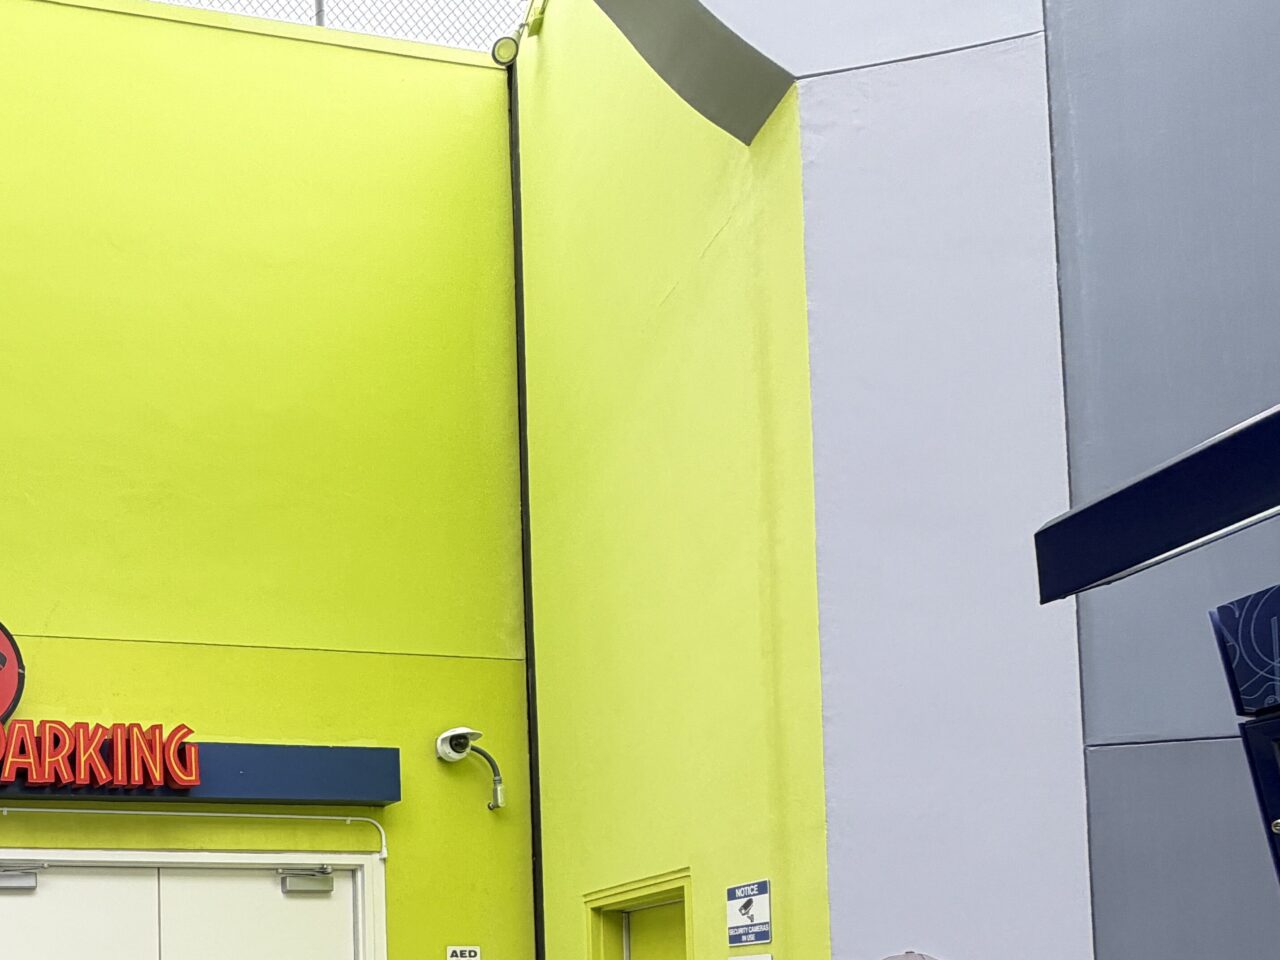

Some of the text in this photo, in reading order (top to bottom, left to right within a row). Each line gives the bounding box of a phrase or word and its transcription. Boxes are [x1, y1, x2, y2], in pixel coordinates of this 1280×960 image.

[735, 884, 759, 898] NOTICE
[729, 923, 769, 936] SECURITY CAMERAS
[450, 949, 478, 958] AED
